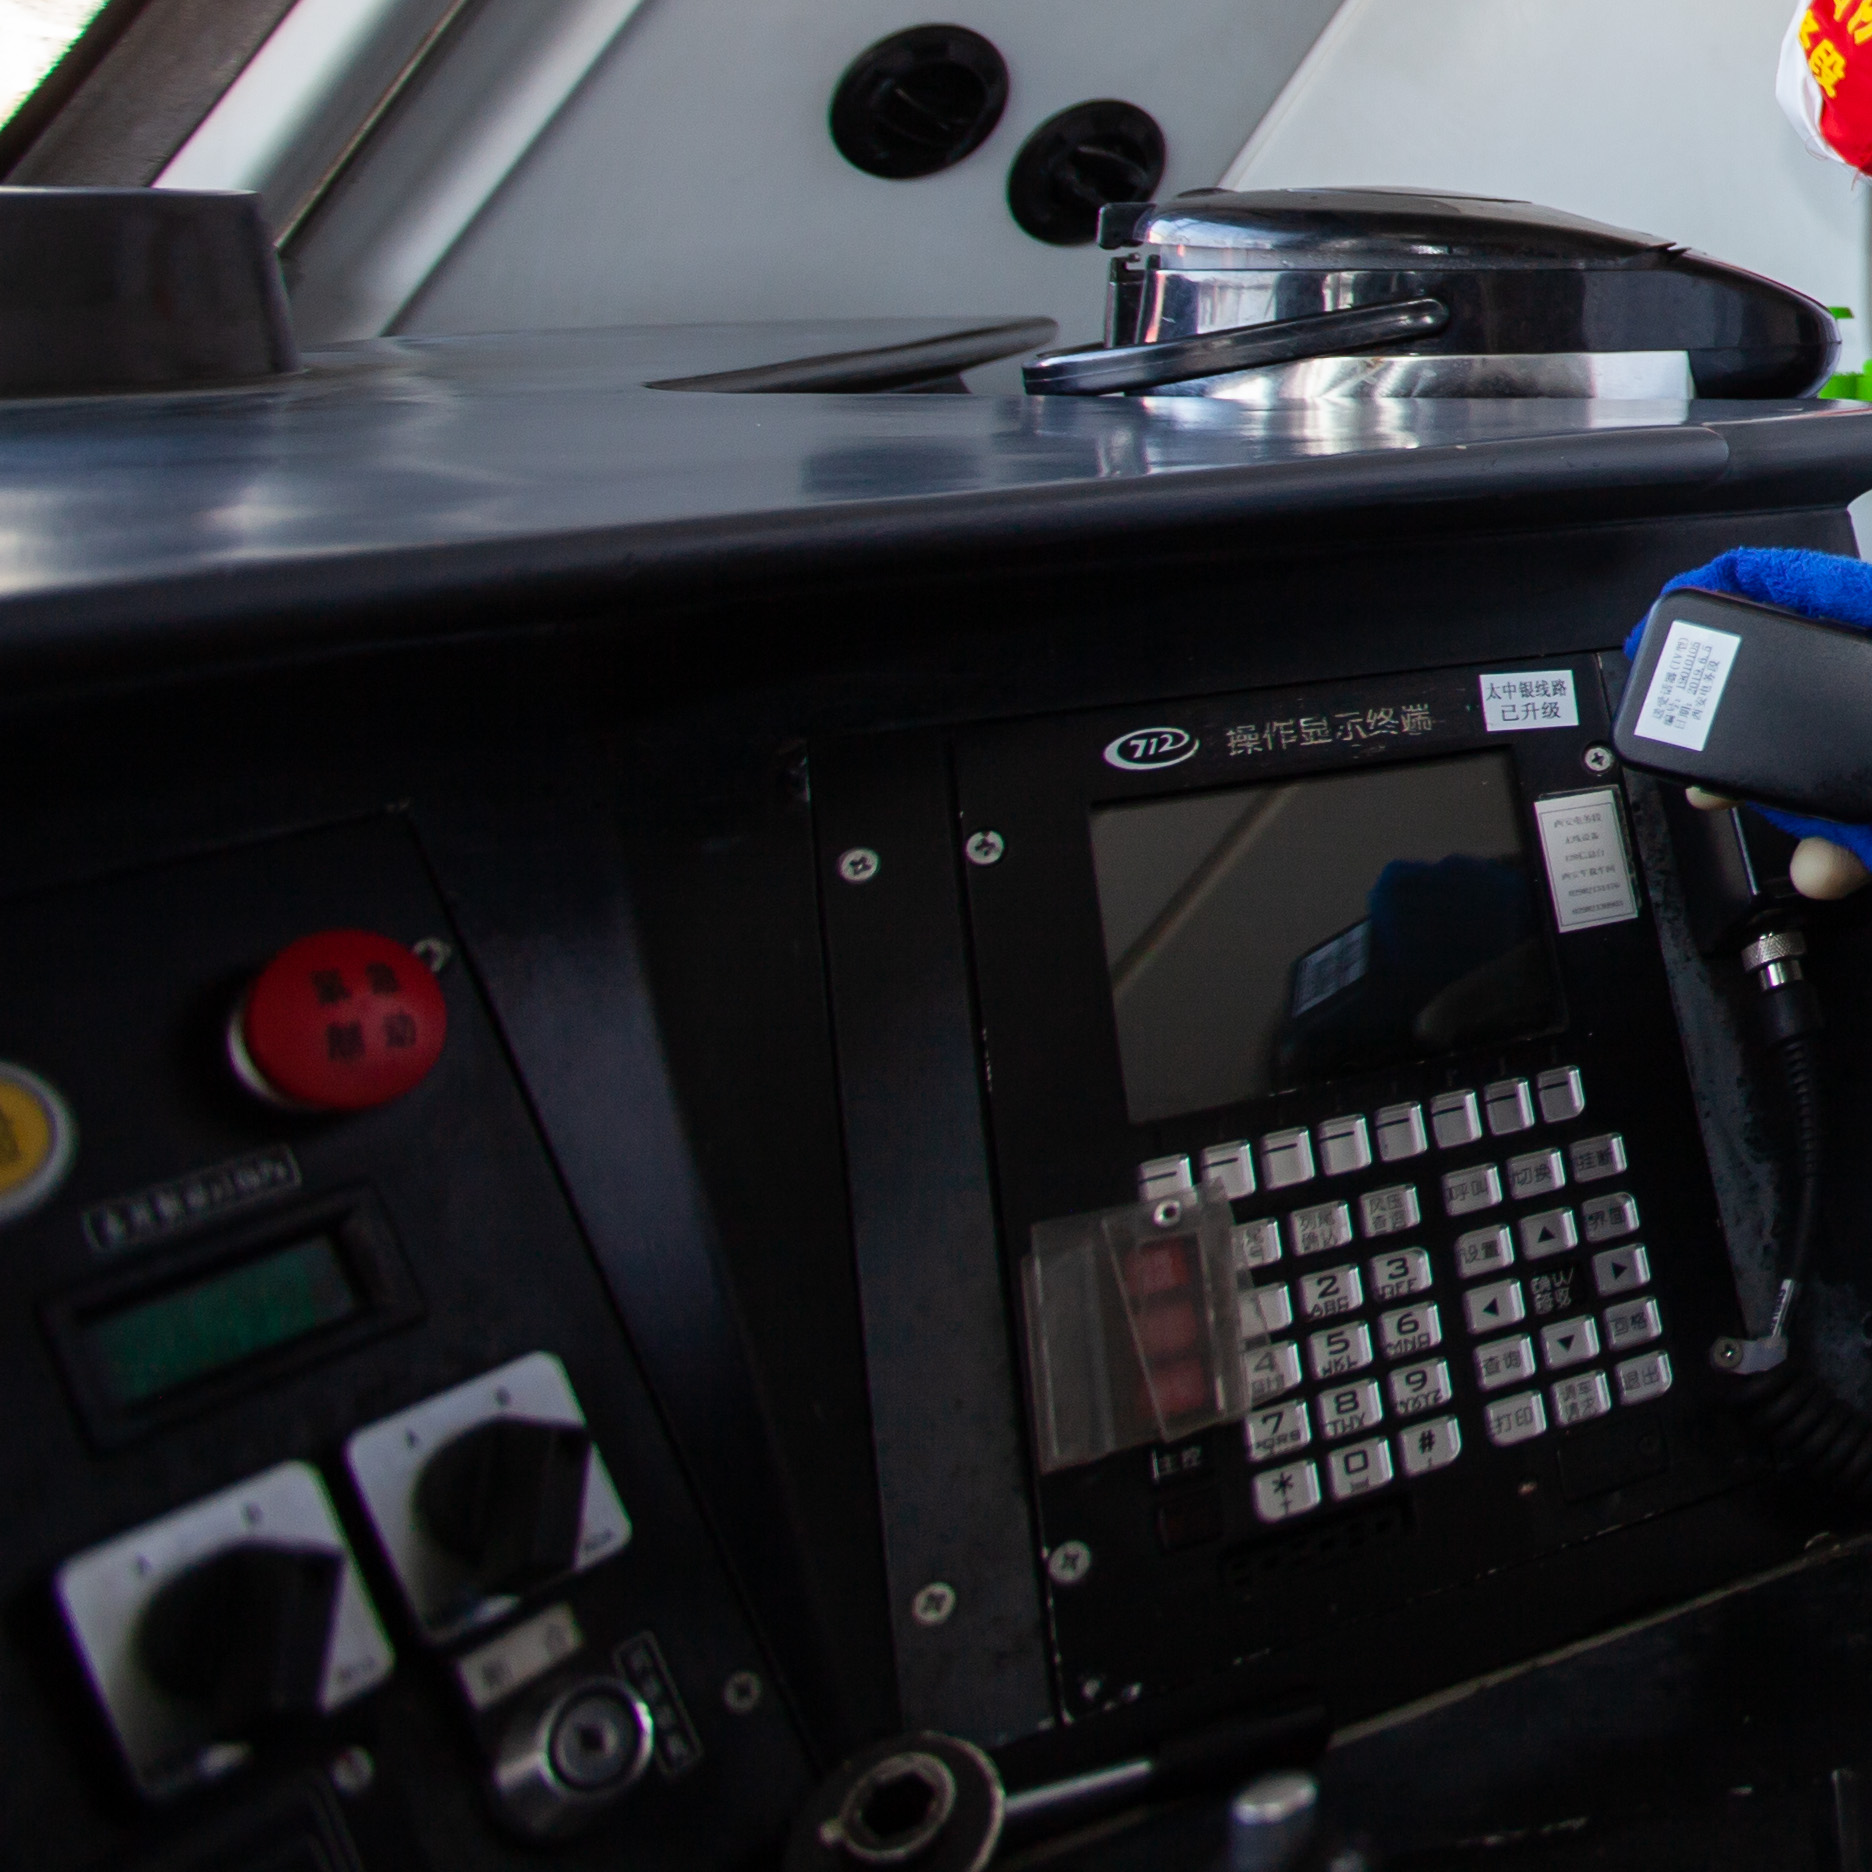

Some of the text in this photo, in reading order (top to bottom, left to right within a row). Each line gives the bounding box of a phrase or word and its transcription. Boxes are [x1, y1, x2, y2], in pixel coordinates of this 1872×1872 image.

[1485, 678, 1568, 701] 太中银线路
[1500, 701, 1562, 722] 已升级
[1226, 703, 1433, 757] 操作显示终端
[1130, 734, 1175, 759] 712
[1447, 1180, 1487, 1202] 呼叫
[1459, 1239, 1499, 1264] 设置
[1387, 1257, 1409, 1280] 3
[1317, 1275, 1340, 1299] 2
[1396, 1311, 1419, 1335] 6
[1327, 1331, 1350, 1355] 5
[1254, 1352, 1275, 1373] 4
[1482, 1349, 1522, 1376] 查询
[1405, 1369, 1428, 1393] 9
[1335, 1389, 1360, 1415] 8
[1261, 1411, 1285, 1435] 7
[1495, 1406, 1534, 1435] 打印
[1344, 1450, 1369, 1475] 0
